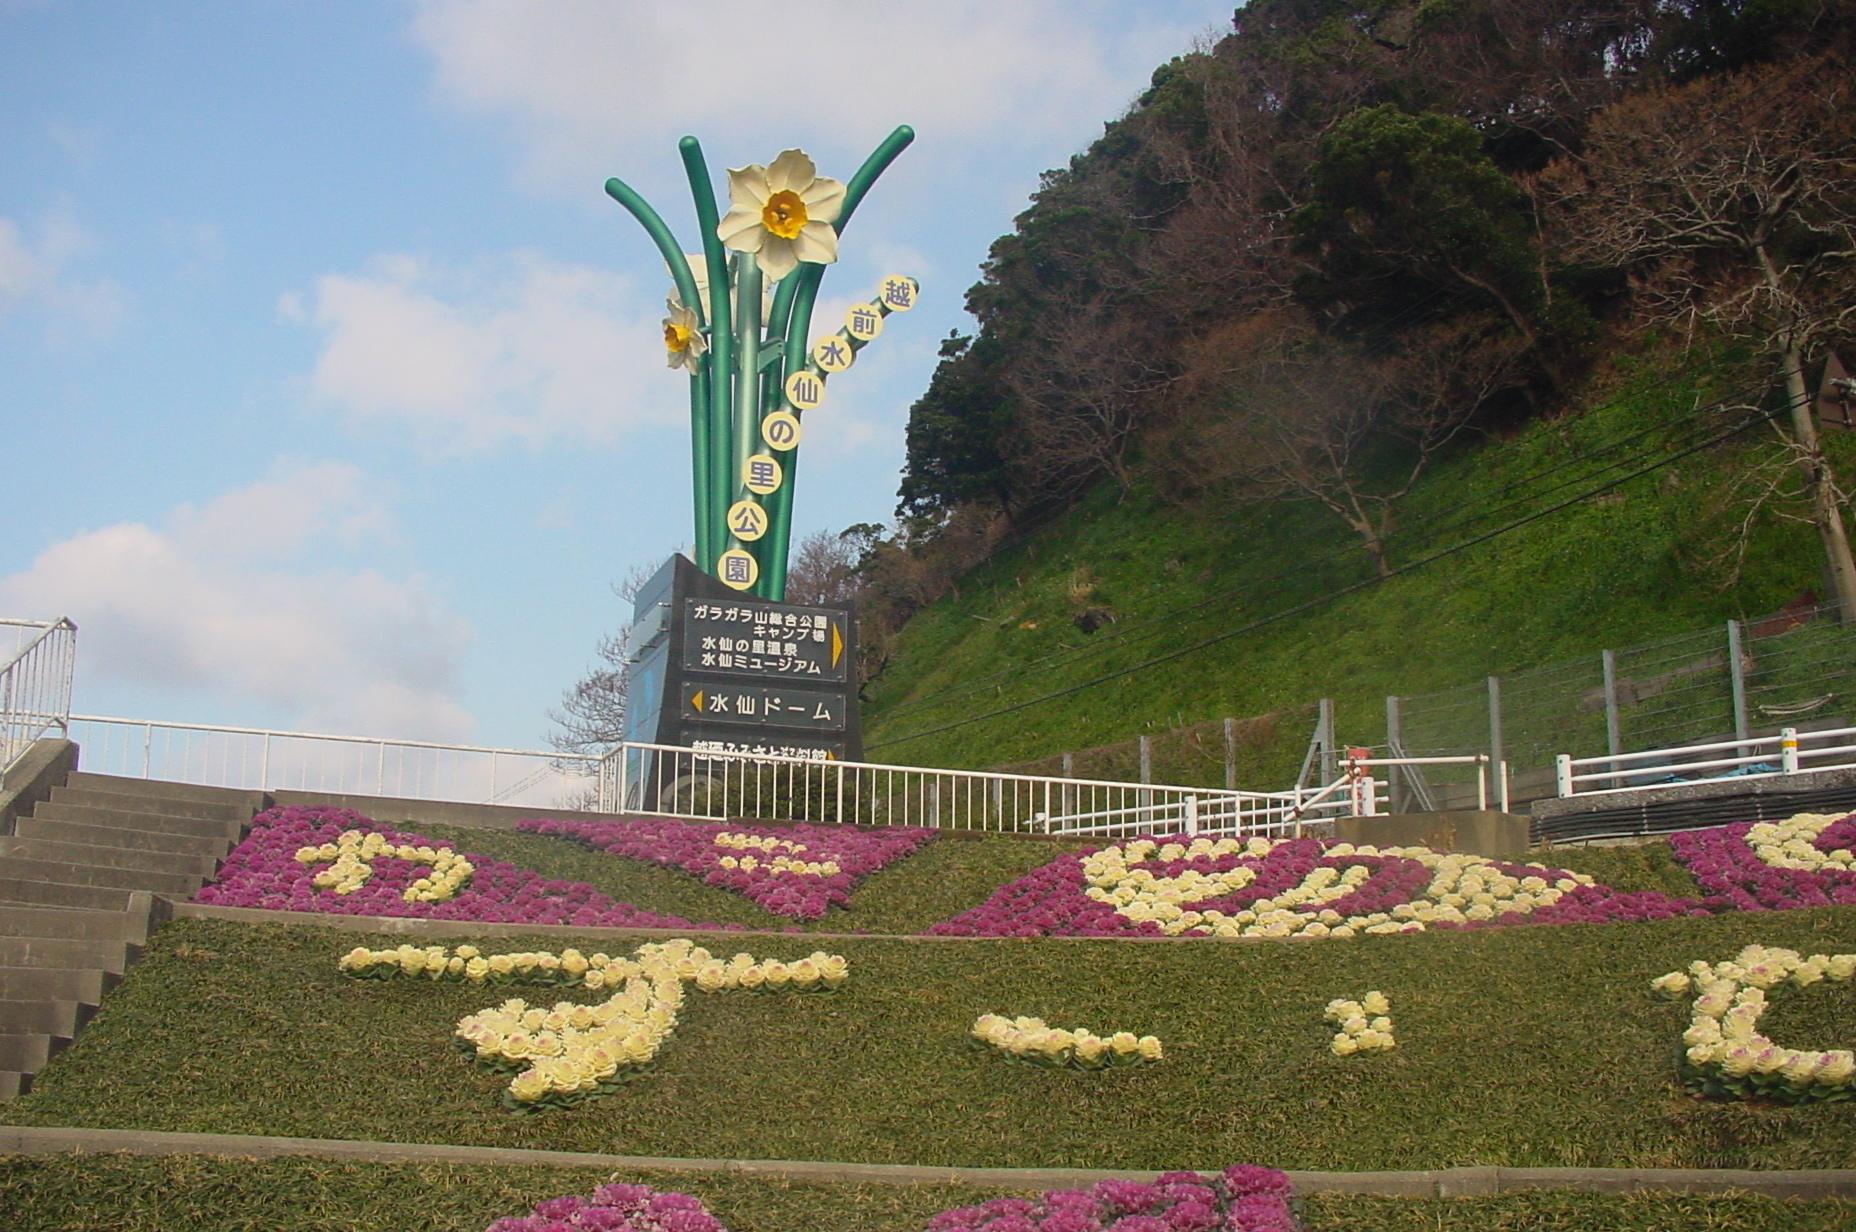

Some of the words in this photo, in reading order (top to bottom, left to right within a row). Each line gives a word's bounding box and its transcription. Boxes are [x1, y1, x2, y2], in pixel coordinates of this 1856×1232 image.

[725, 281, 911, 584] 越前水仙の里公園
[694, 605, 828, 629] ガラガラ山総合公園
[753, 625, 825, 642] キャンプ場
[702, 636, 798, 657] 水仙の里温泉
[701, 653, 821, 674] 水仙ミュージアム
[709, 694, 831, 721] 水仙ドーム
